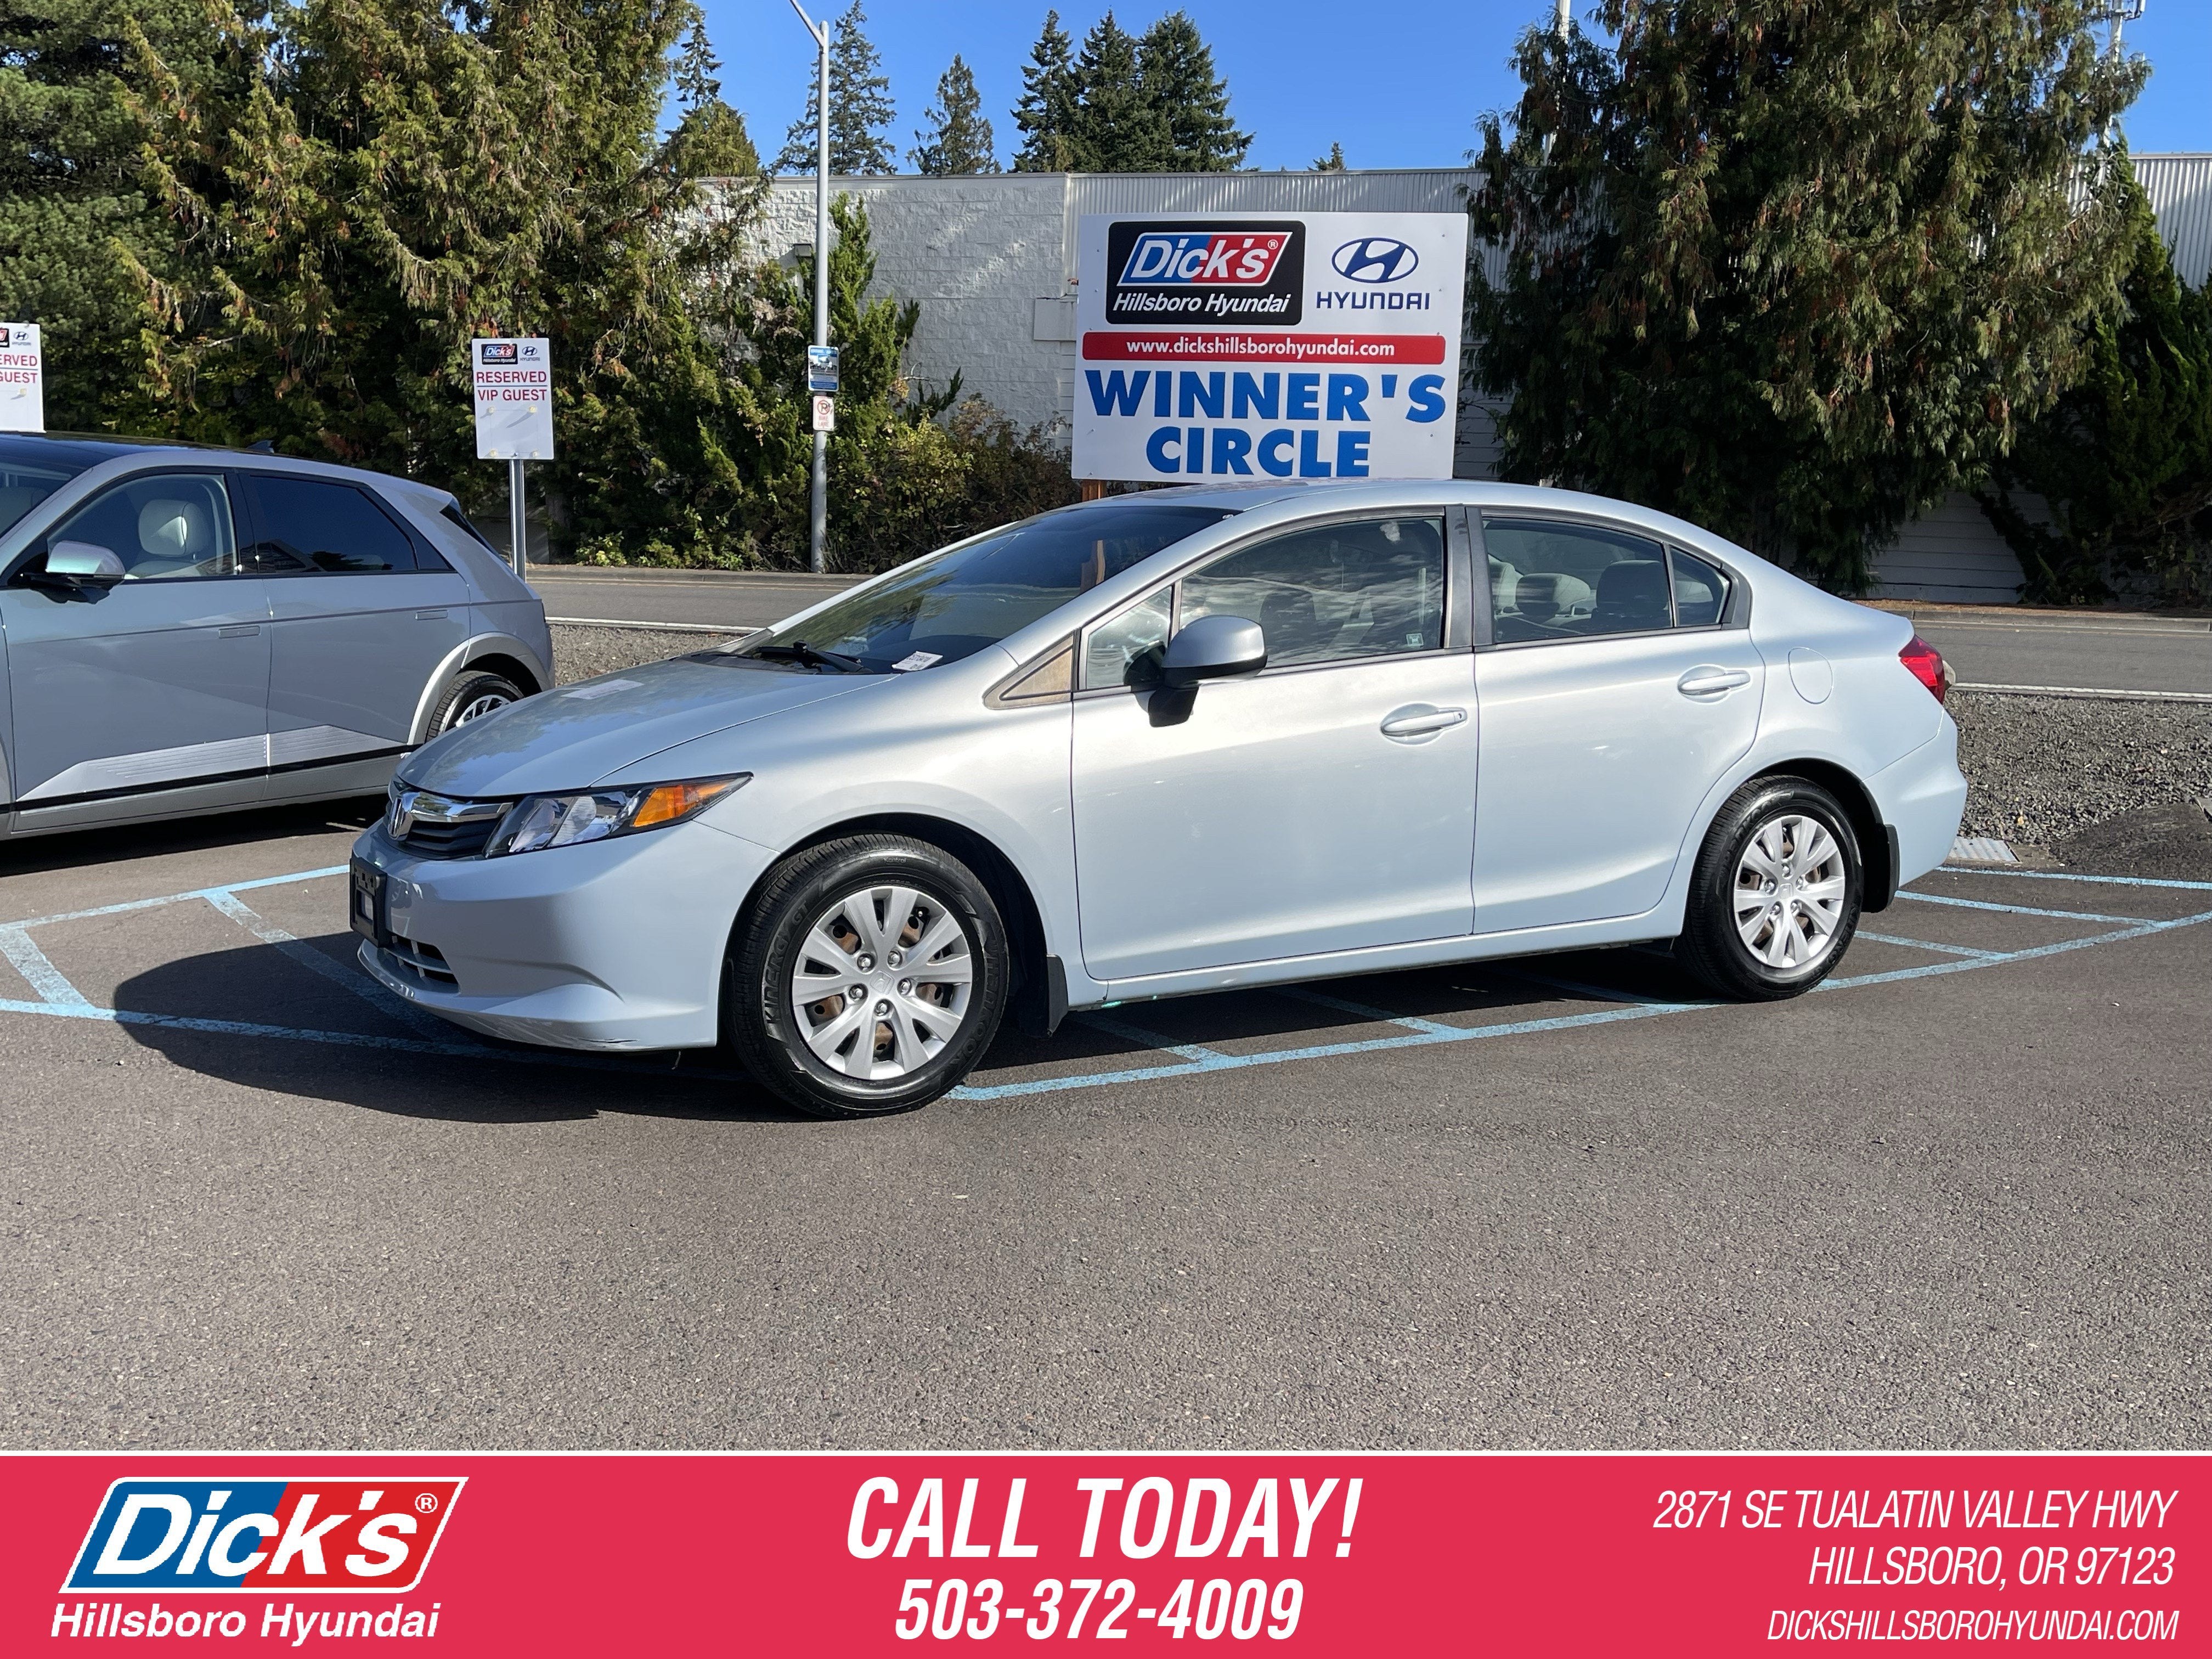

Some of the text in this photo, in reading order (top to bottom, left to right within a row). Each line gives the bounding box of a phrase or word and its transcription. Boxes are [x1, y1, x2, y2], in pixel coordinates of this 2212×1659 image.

[1113, 292, 1291, 317] Hillsboro Hyundai
[1317, 291, 1430, 310] HYUNDAI
[1126, 336, 1395, 359] www.dickshillsborohyundai.com
[476, 371, 547, 383] RESERVED
[478, 389, 547, 401] VIP GUEST
[1085, 369, 1446, 423] WINNER'S
[1146, 426, 1370, 478] CIRCLE
